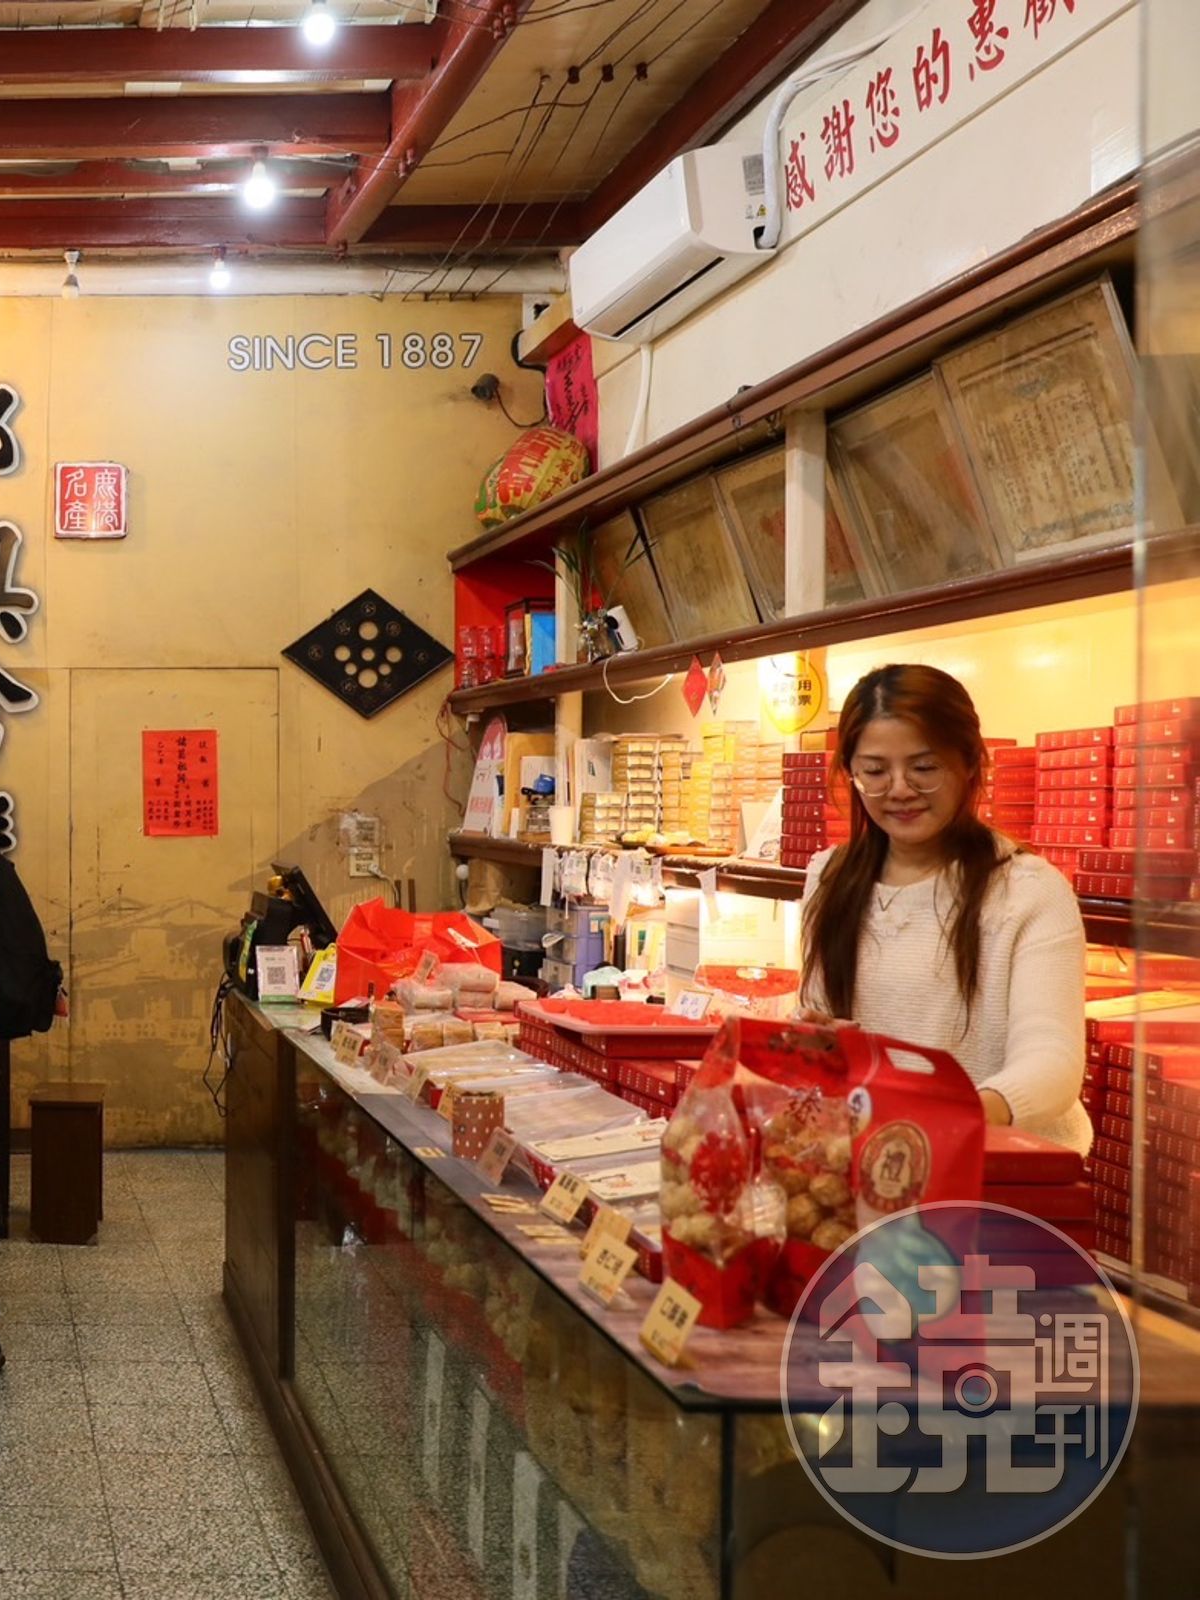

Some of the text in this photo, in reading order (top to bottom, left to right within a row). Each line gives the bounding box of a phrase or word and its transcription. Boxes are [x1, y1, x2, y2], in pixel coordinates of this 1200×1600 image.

[227, 333, 484, 371] SINCE 1887
[63, 468, 89, 530] 名產
